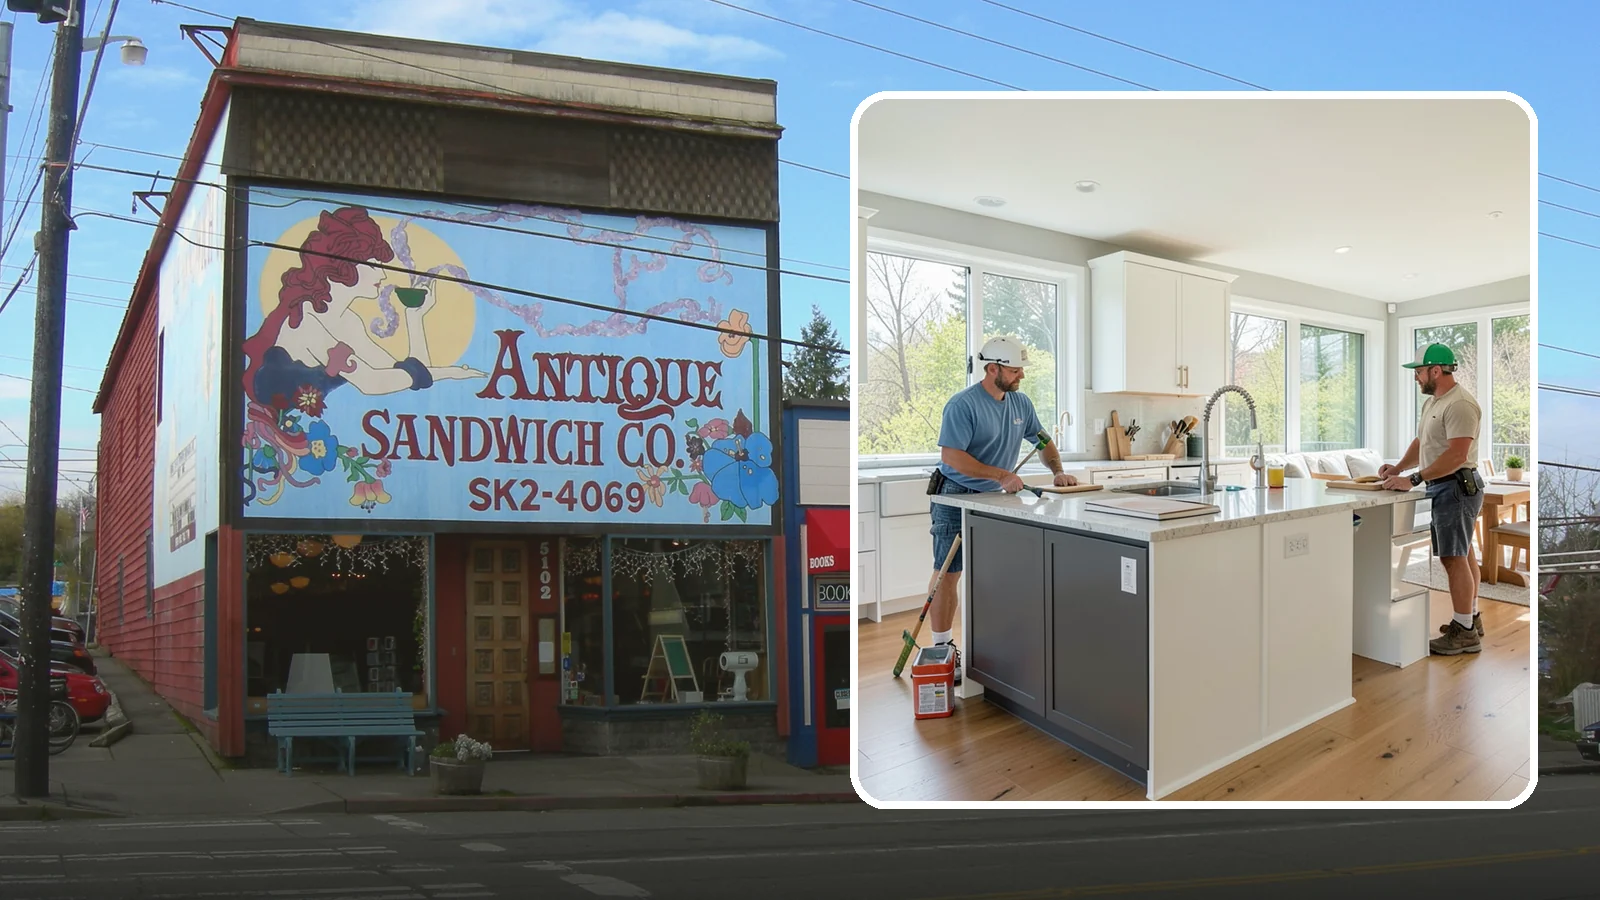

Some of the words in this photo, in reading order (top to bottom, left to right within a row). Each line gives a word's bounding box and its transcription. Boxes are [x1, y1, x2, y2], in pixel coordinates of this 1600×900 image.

[475, 328, 724, 421] ANTIQUE
[361, 408, 605, 467] SANDWICH
[617, 422, 685, 468] CO.
[468, 477, 646, 513] SK2-4069
[539, 541, 552, 600] 5102
[809, 554, 835, 569] BOOKS
